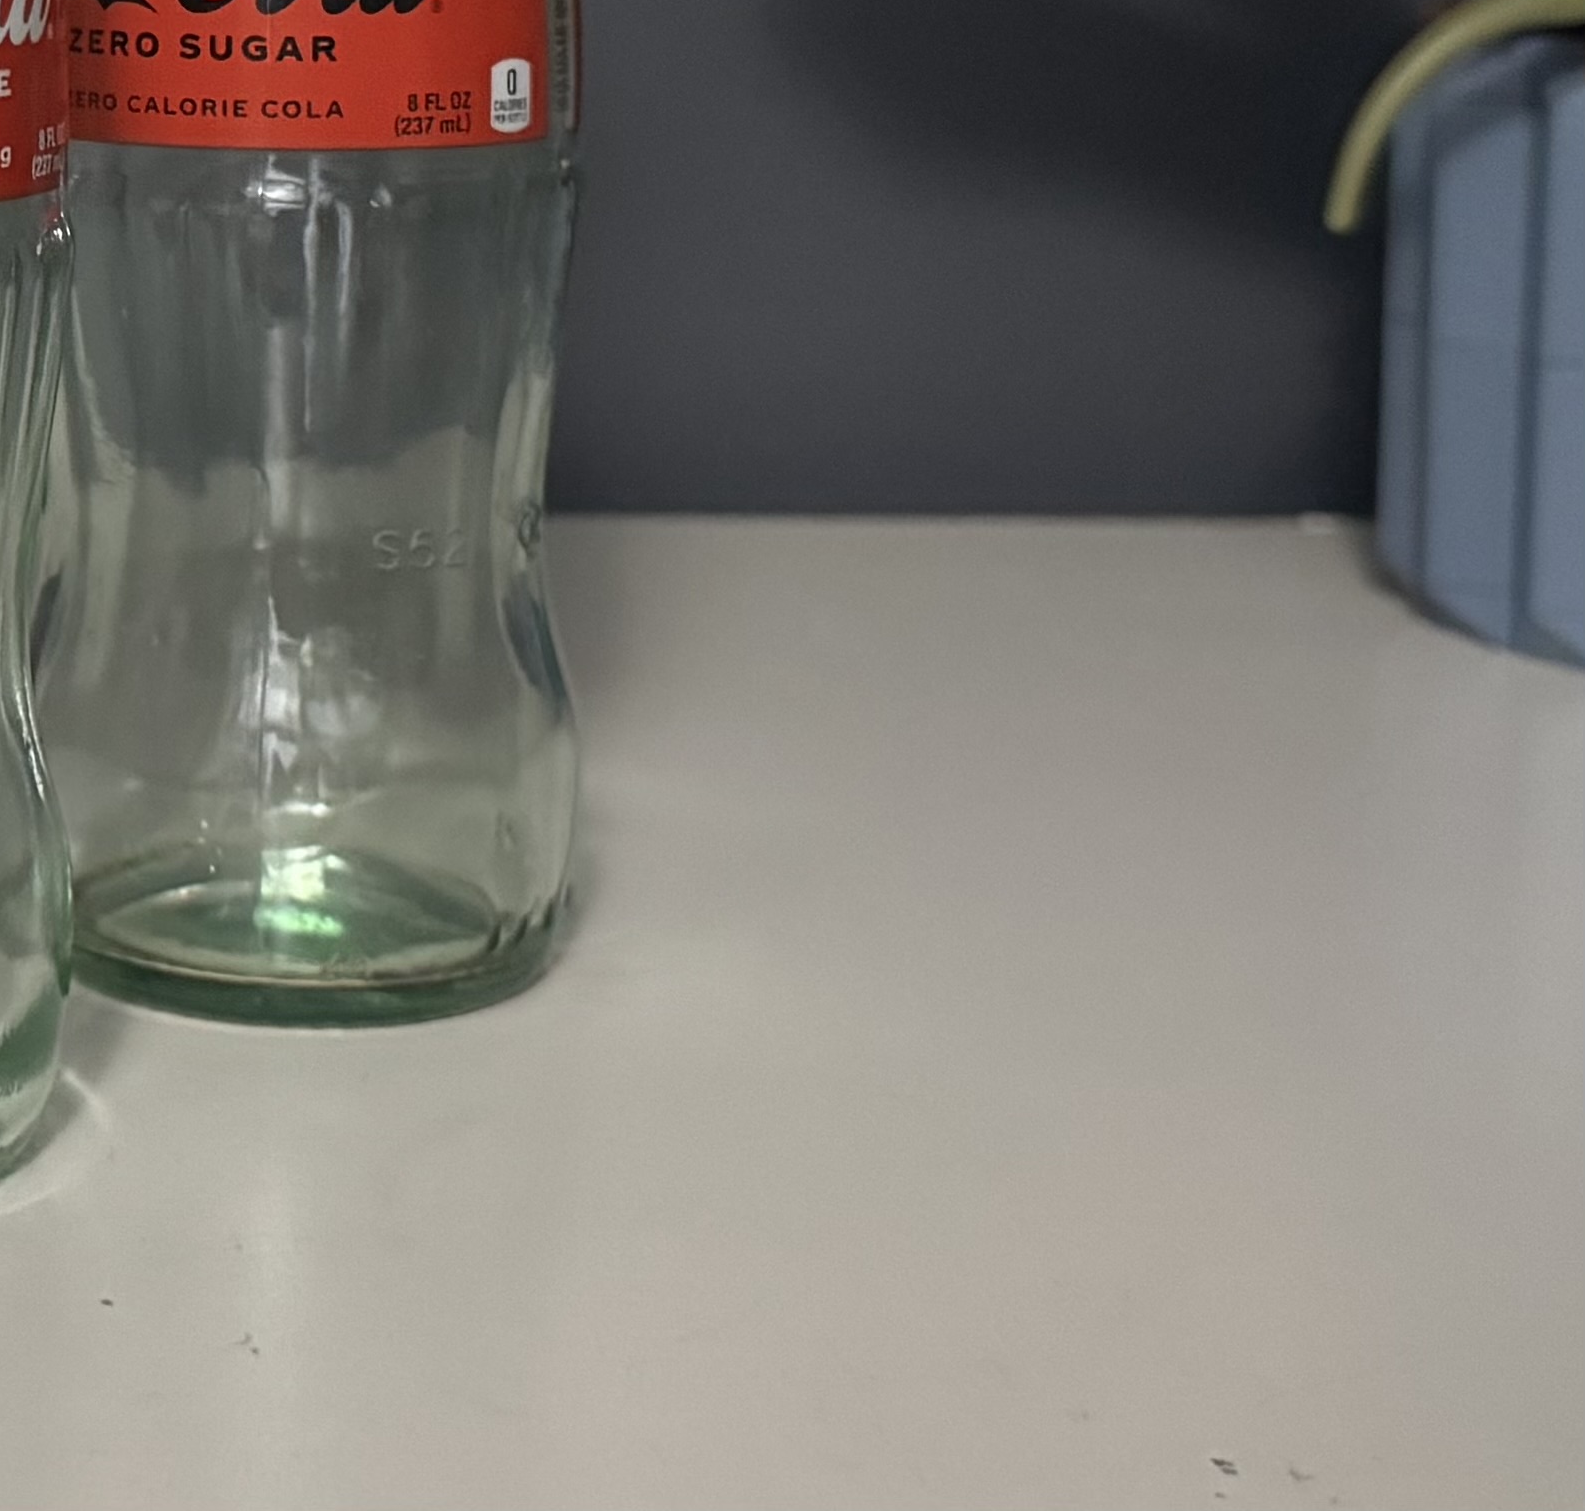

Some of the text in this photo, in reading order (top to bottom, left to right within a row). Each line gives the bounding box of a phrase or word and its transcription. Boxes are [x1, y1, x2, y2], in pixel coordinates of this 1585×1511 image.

[68, 27, 338, 62] ZERO SUGAR
[507, 68, 517, 96] 0
[68, 91, 344, 119] ERO CALORIE COLA
[407, 91, 472, 112] 8 FL OZ
[395, 114, 434, 137] (237
[439, 112, 471, 134] mL)
